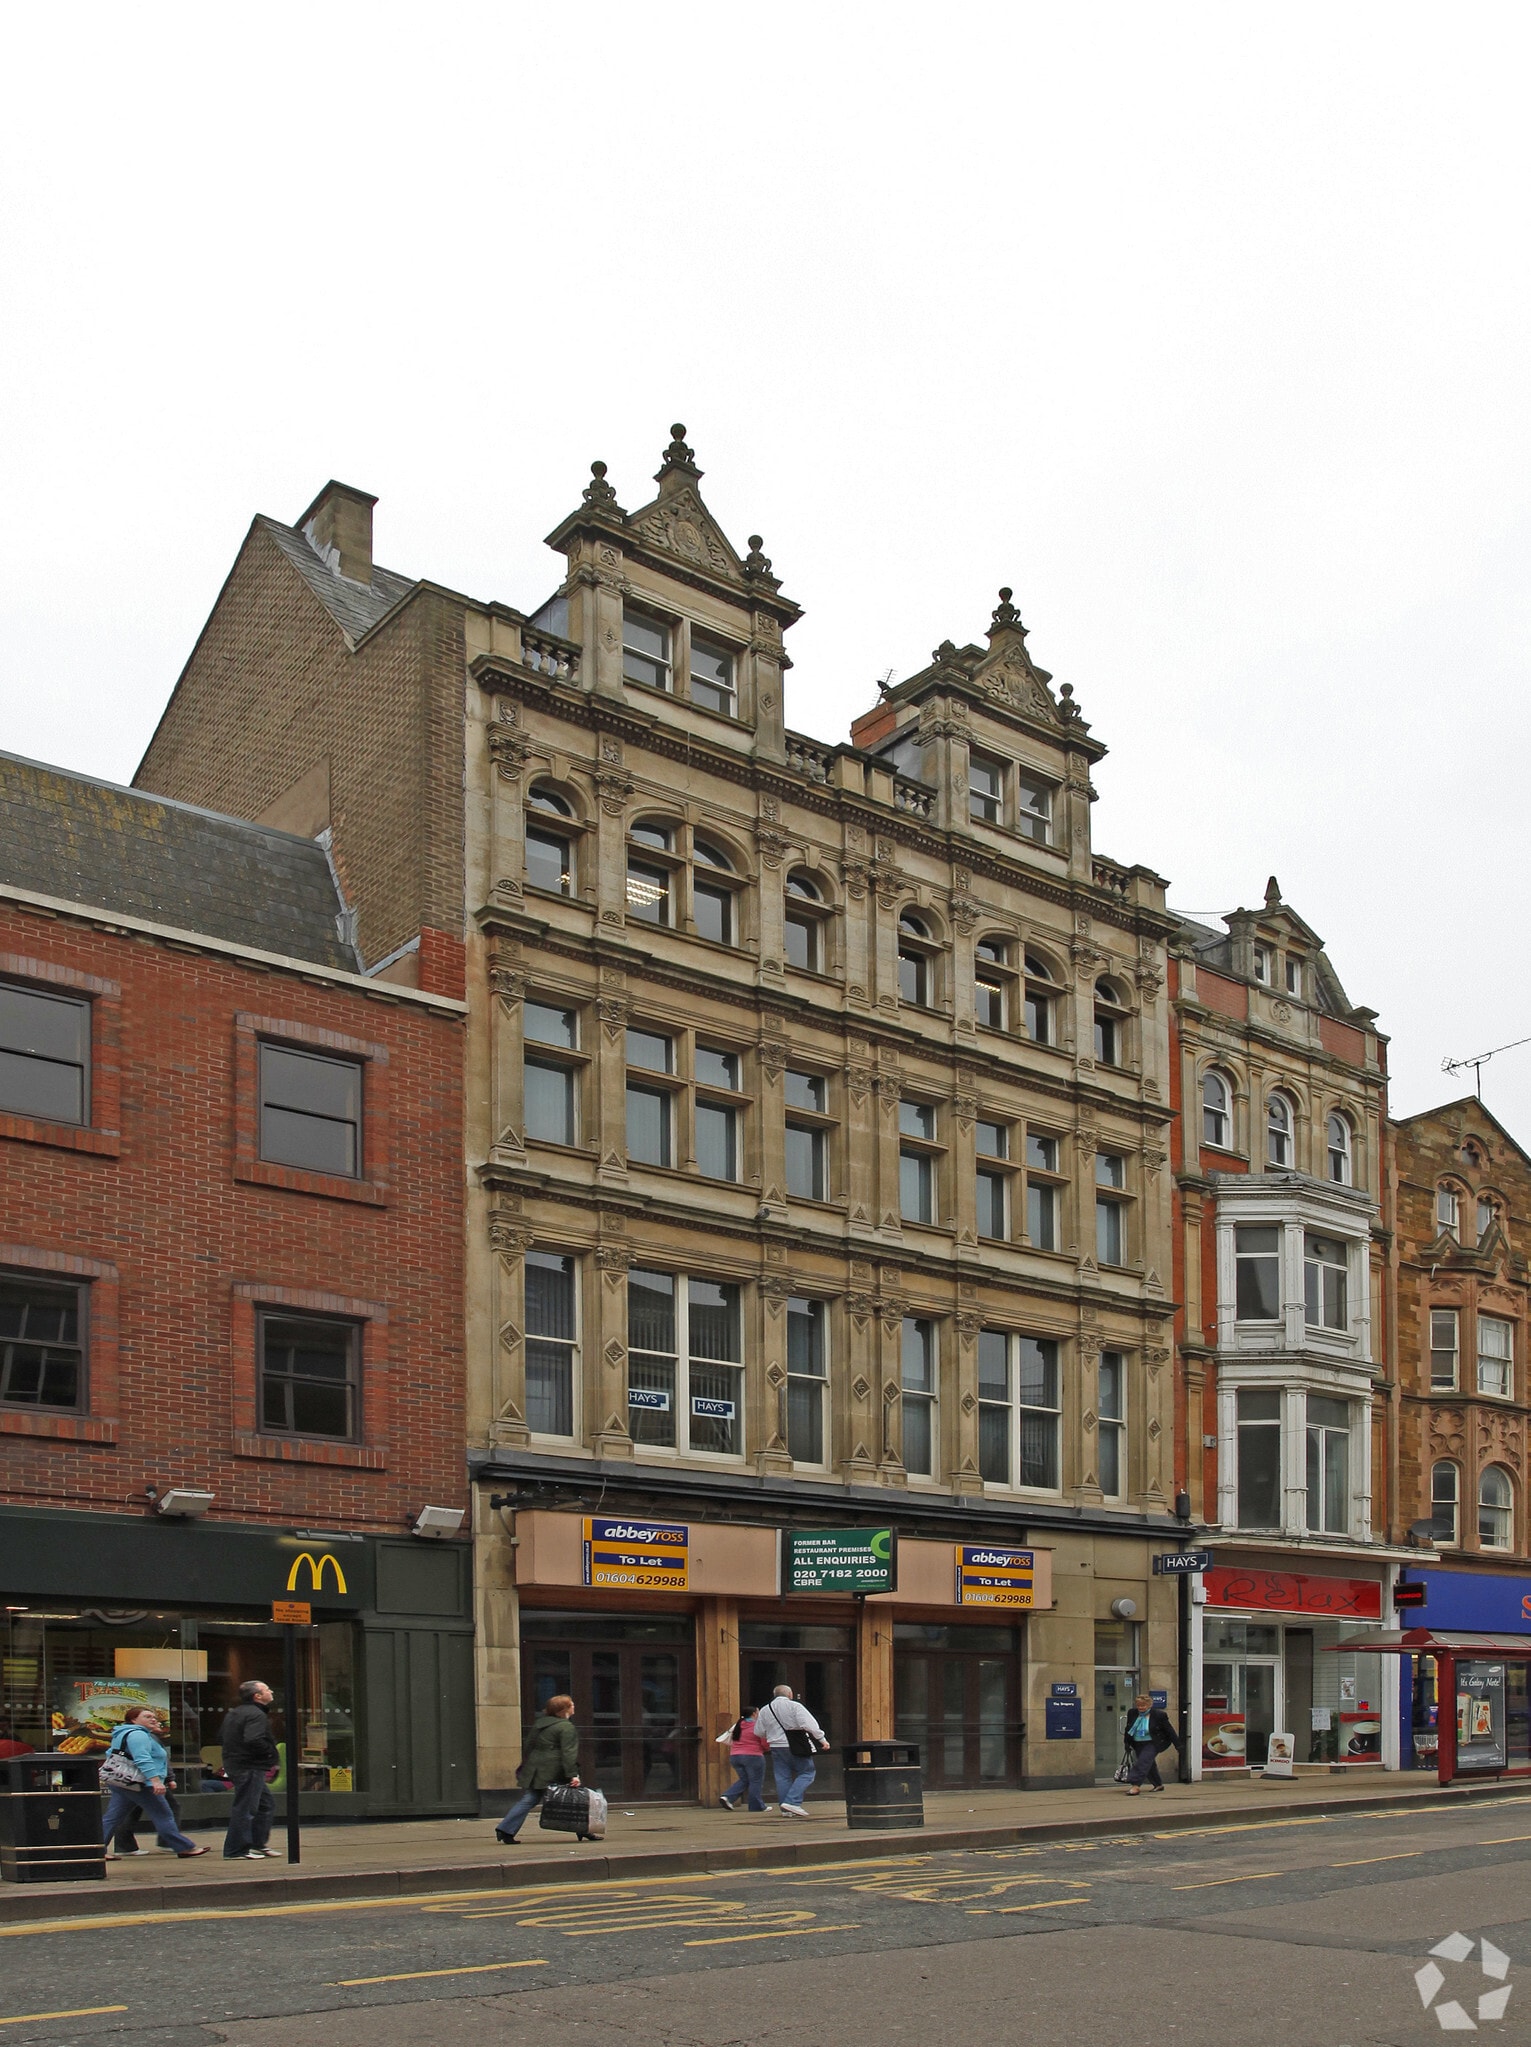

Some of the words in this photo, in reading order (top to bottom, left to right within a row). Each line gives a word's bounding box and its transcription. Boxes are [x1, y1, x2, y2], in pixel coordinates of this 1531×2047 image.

[629, 1392, 658, 1404] HAYS
[697, 1401, 724, 1413] HAYS
[604, 1525, 684, 1543] abbeyross
[619, 1555, 636, 1565] To
[640, 1557, 663, 1566] Let
[816, 1556, 876, 1565] ENQUIRIES
[972, 1552, 1031, 1567] abbeyross
[1166, 1556, 1197, 1568] HAYS
[793, 1570, 816, 1578] 020
[821, 1569, 852, 1578] 7182
[856, 1569, 888, 1577] 2000
[979, 1577, 992, 1585] To
[994, 1578, 1012, 1587] Let
